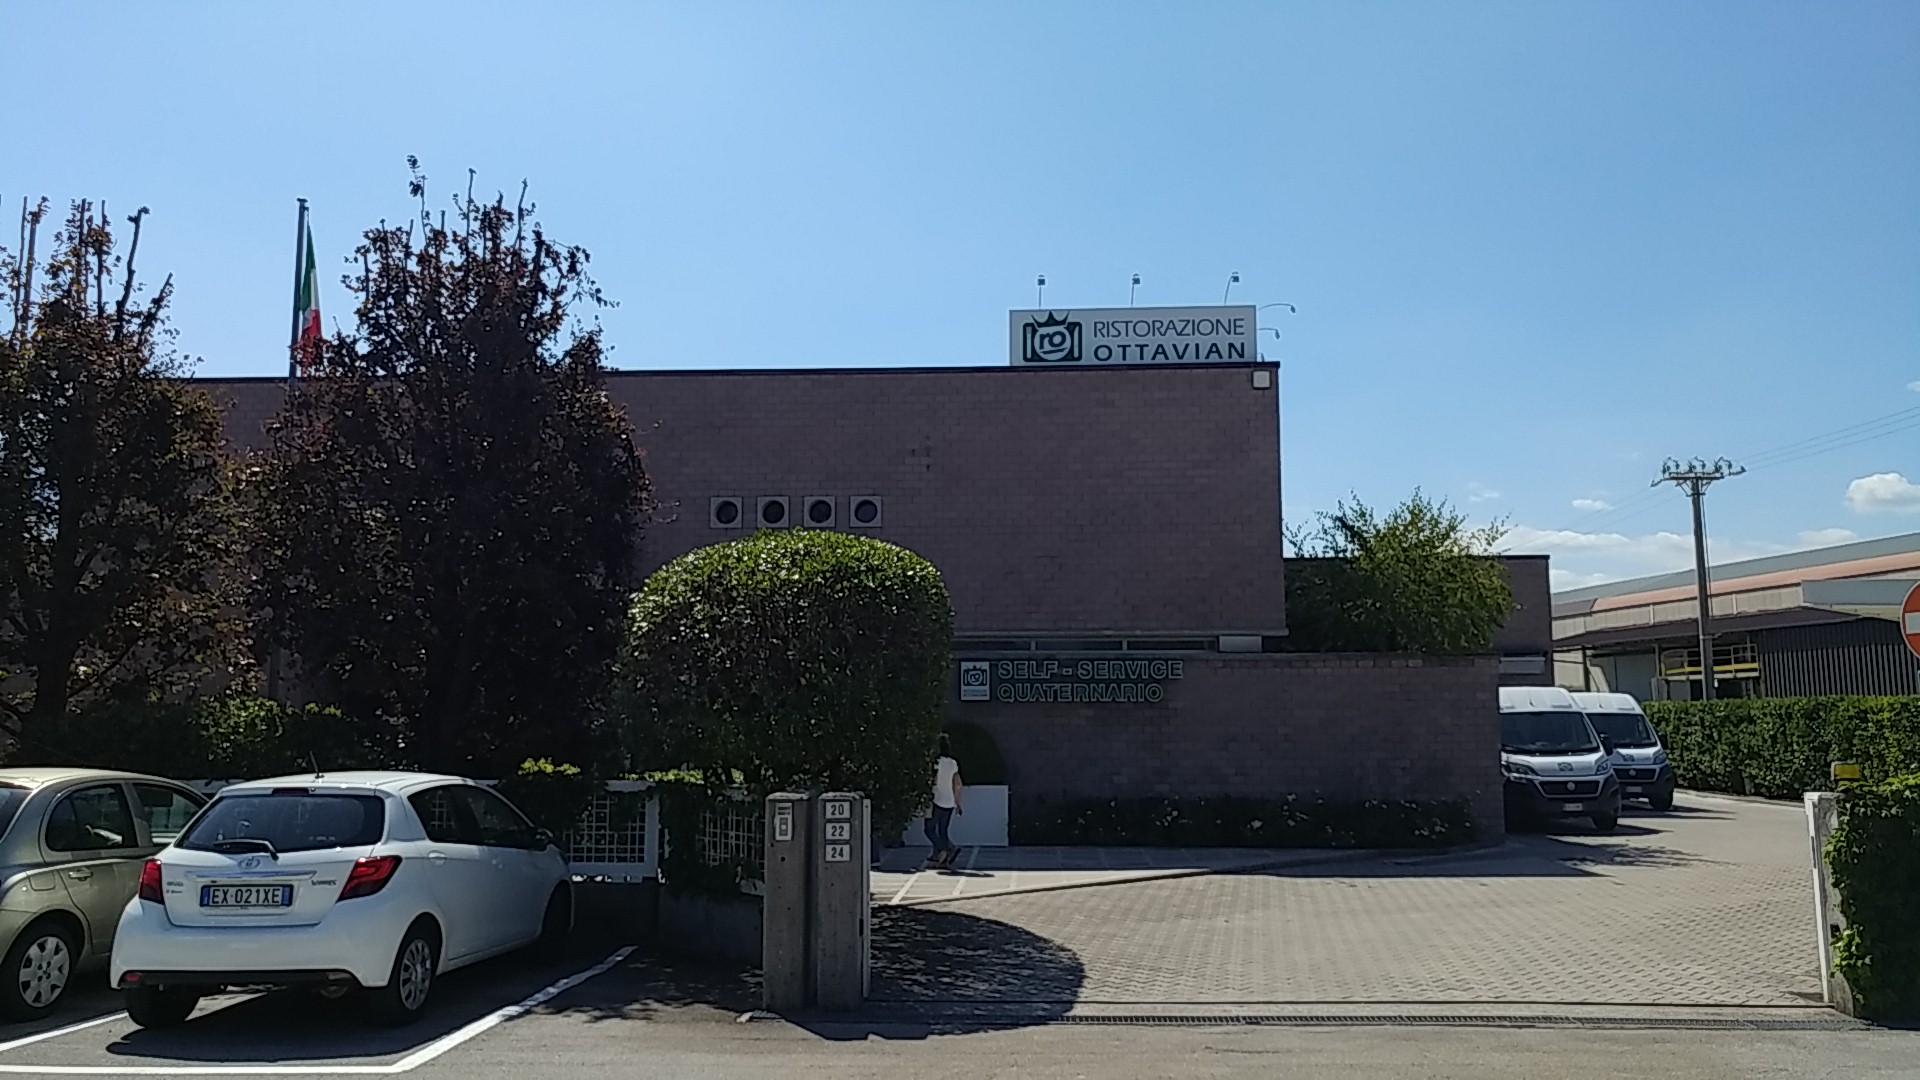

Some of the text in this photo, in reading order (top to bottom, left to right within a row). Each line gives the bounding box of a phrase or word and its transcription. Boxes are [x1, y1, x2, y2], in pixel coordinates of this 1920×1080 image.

[1093, 318, 1246, 338] RISTORAZIONE
[1093, 342, 1246, 362] OTTAVIAN
[997, 660, 1059, 680] SELF
[1077, 660, 1185, 680] SERVICE
[997, 683, 1164, 703] QUATERNARIO
[830, 804, 845, 816] 20
[830, 825, 845, 837] 22
[830, 846, 845, 858] 24
